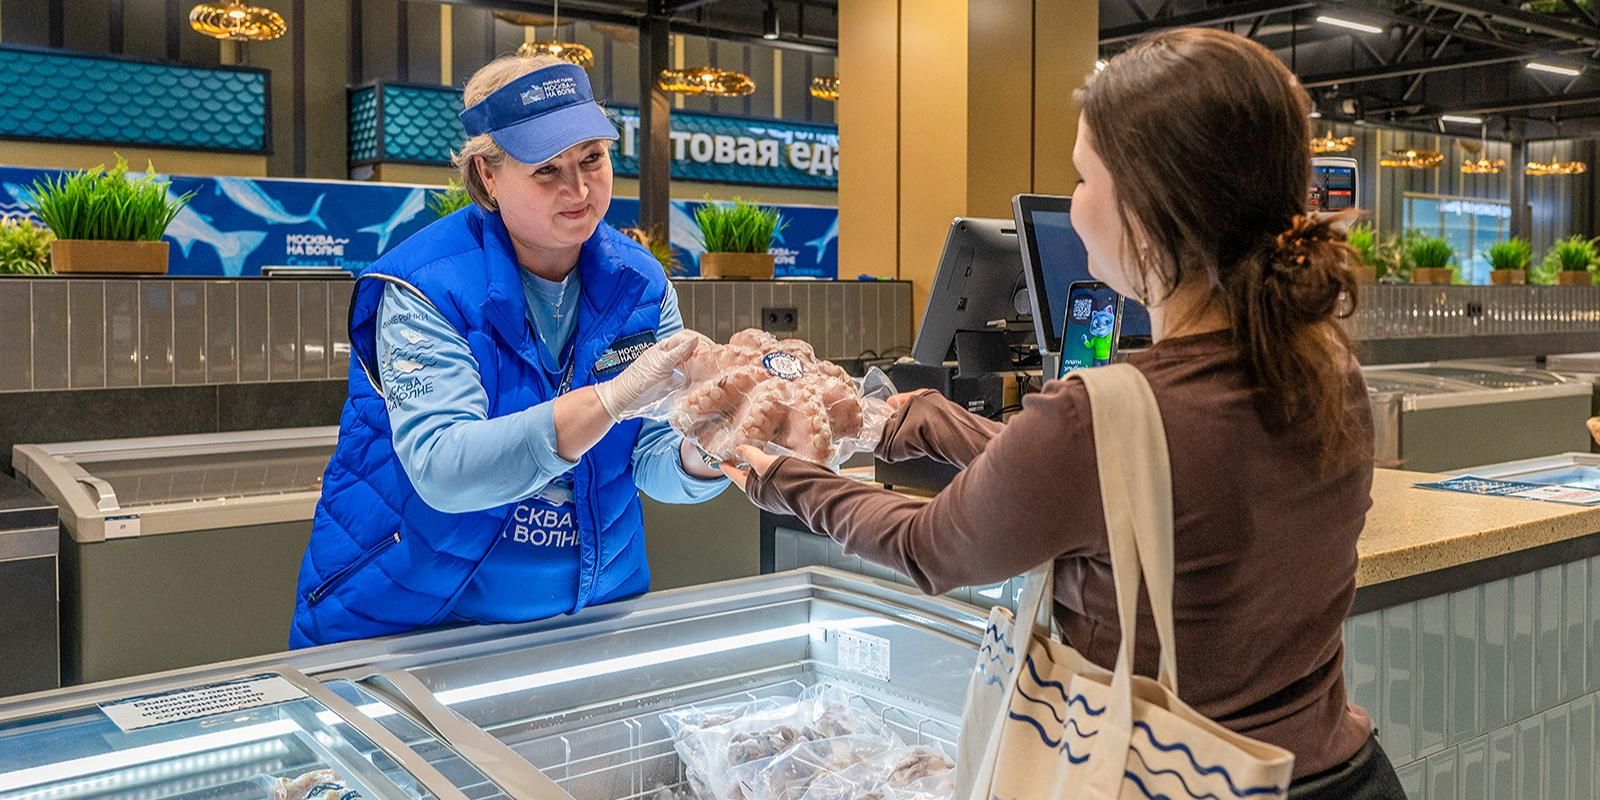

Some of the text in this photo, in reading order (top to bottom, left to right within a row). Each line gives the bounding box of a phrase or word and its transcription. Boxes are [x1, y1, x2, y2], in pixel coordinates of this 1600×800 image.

[543, 82, 571, 93] МОСКВА
[545, 89, 557, 98] НА
[622, 116, 779, 167] Гтовая
[286, 234, 334, 245] МОСКВА
[286, 245, 344, 256] НА ВОЛНЕ
[618, 342, 649, 355] МОСКВА
[620, 352, 632, 363] НА
[133, 694, 195, 708] Выдача
[199, 684, 251, 696] товара
[143, 689, 252, 711] производится
[141, 692, 265, 717] исключительно
[155, 697, 263, 720] сотрудником!
